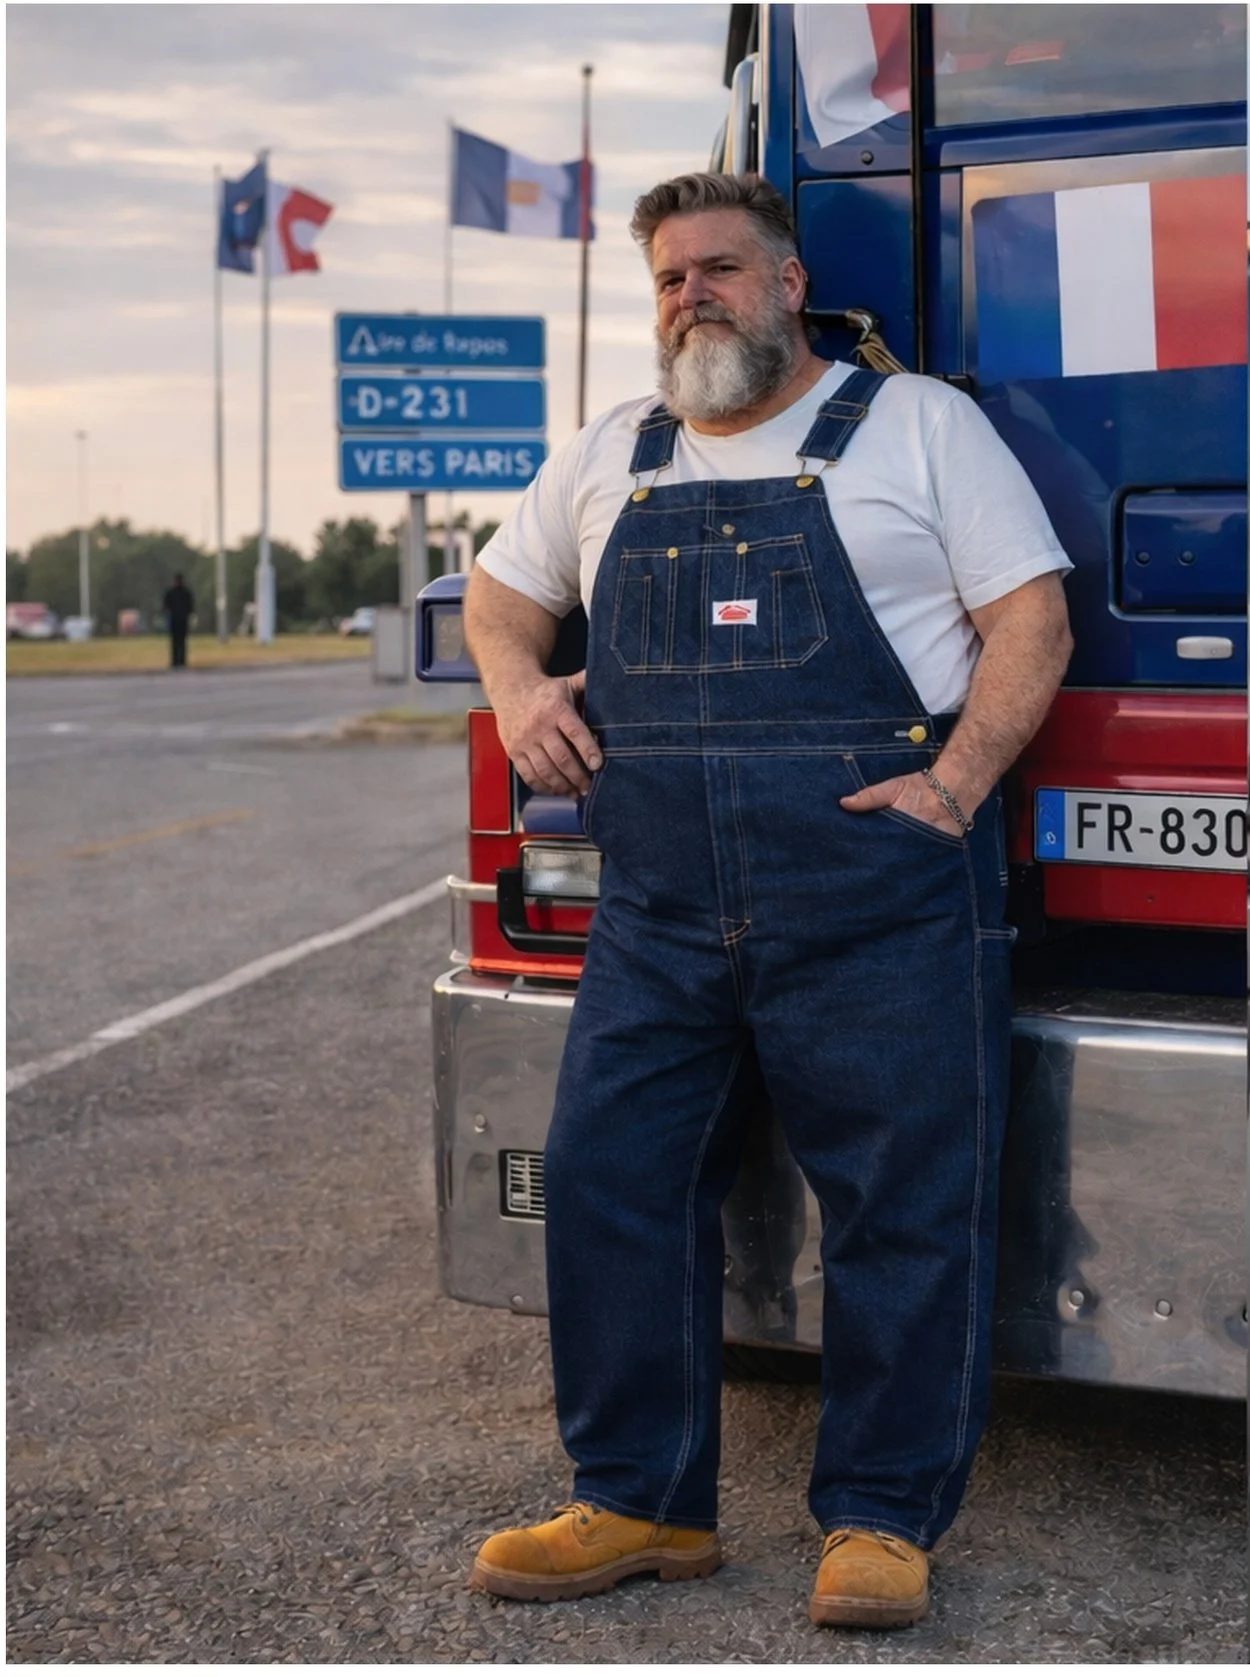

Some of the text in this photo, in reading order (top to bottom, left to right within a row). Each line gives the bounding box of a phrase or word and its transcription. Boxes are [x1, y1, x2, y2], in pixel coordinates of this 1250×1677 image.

[352, 447, 534, 478] VERS PARIS
[1076, 801, 1248, 858] FR-830
